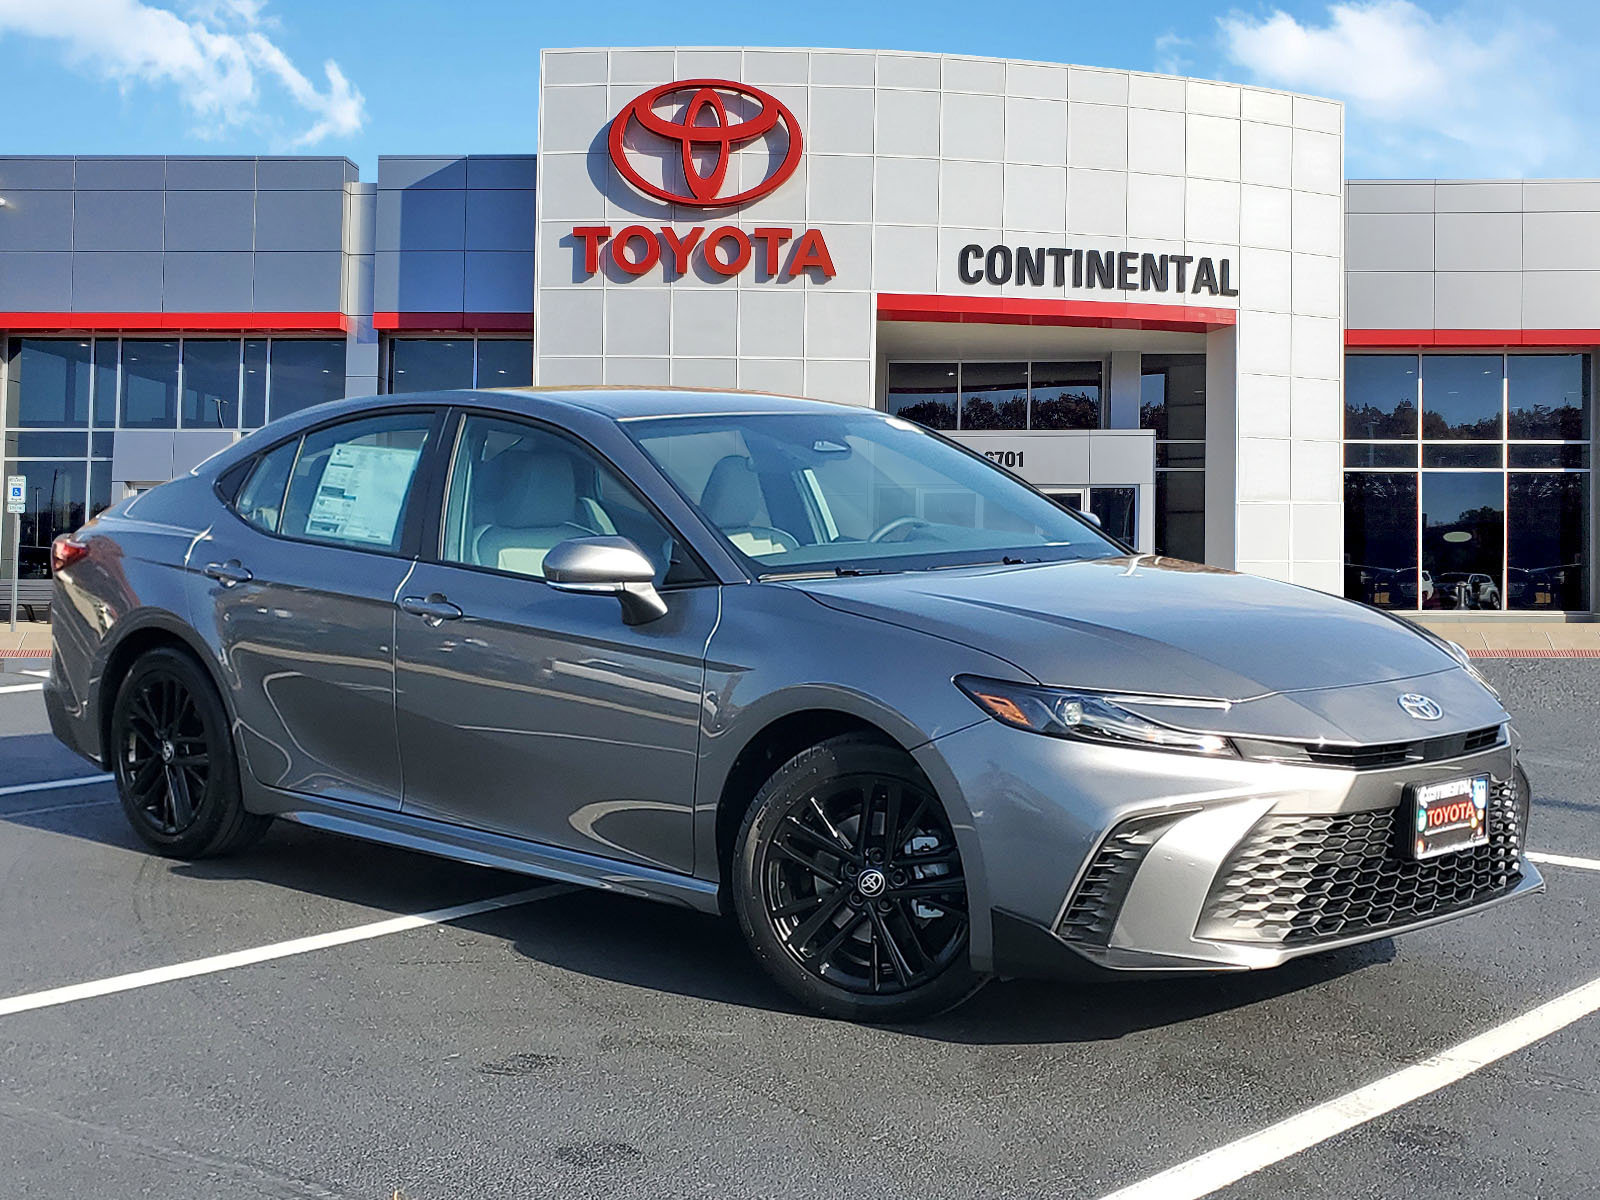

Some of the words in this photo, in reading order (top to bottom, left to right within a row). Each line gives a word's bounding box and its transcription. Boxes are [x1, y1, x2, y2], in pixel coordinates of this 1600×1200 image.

[572, 225, 837, 277] TOYOTA
[958, 244, 1239, 297] CONTINENTAL
[1427, 801, 1476, 827] TOYOTA
